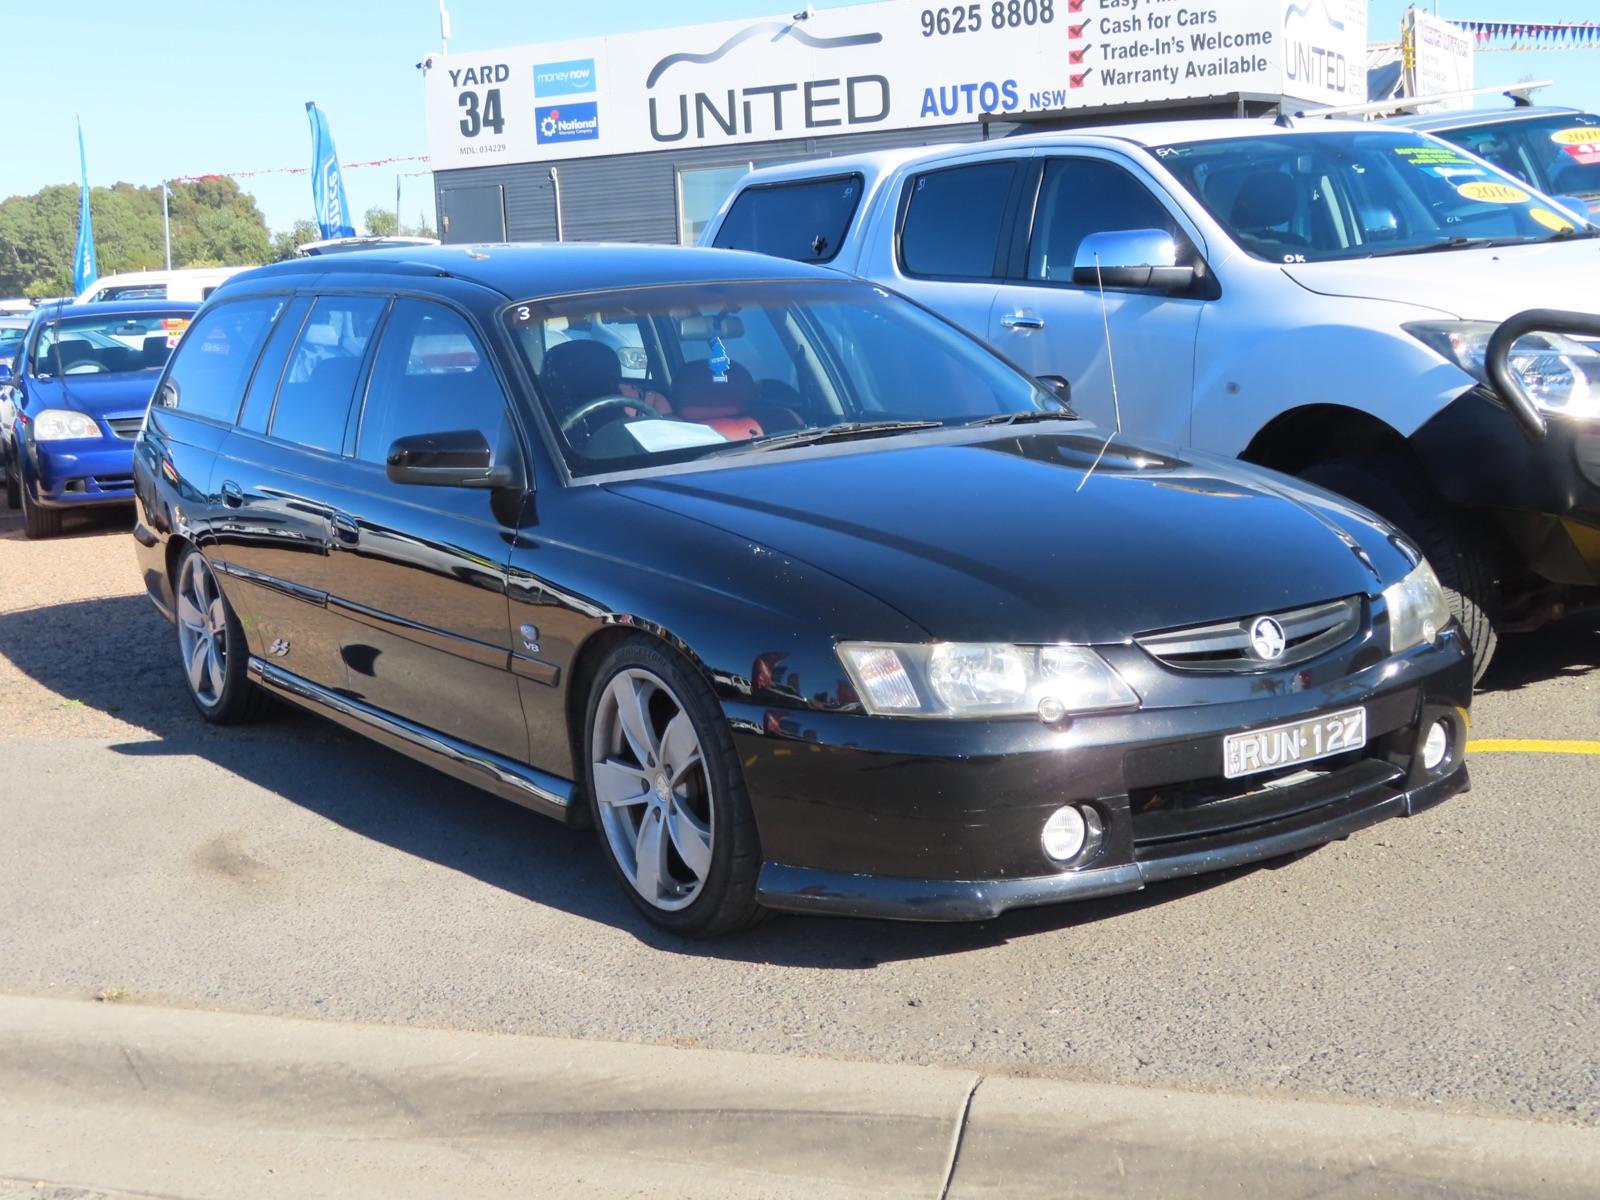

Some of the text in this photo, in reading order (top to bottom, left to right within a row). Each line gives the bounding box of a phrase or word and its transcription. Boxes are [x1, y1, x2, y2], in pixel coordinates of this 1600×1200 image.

[921, 0, 1054, 37] 9625 8808
[1100, 7, 1217, 35] Cash for Cars
[1100, 30, 1273, 61] Trade-In's Welcome
[448, 63, 510, 88] YARD
[537, 69, 590, 84] money now
[1100, 54, 1267, 86] Warranty Available
[920, 79, 1067, 118] AUTOS NSW
[458, 88, 505, 138] 34
[558, 116, 597, 131] National
[517, 306, 531, 321] 3
[522, 640, 540, 653] V8
